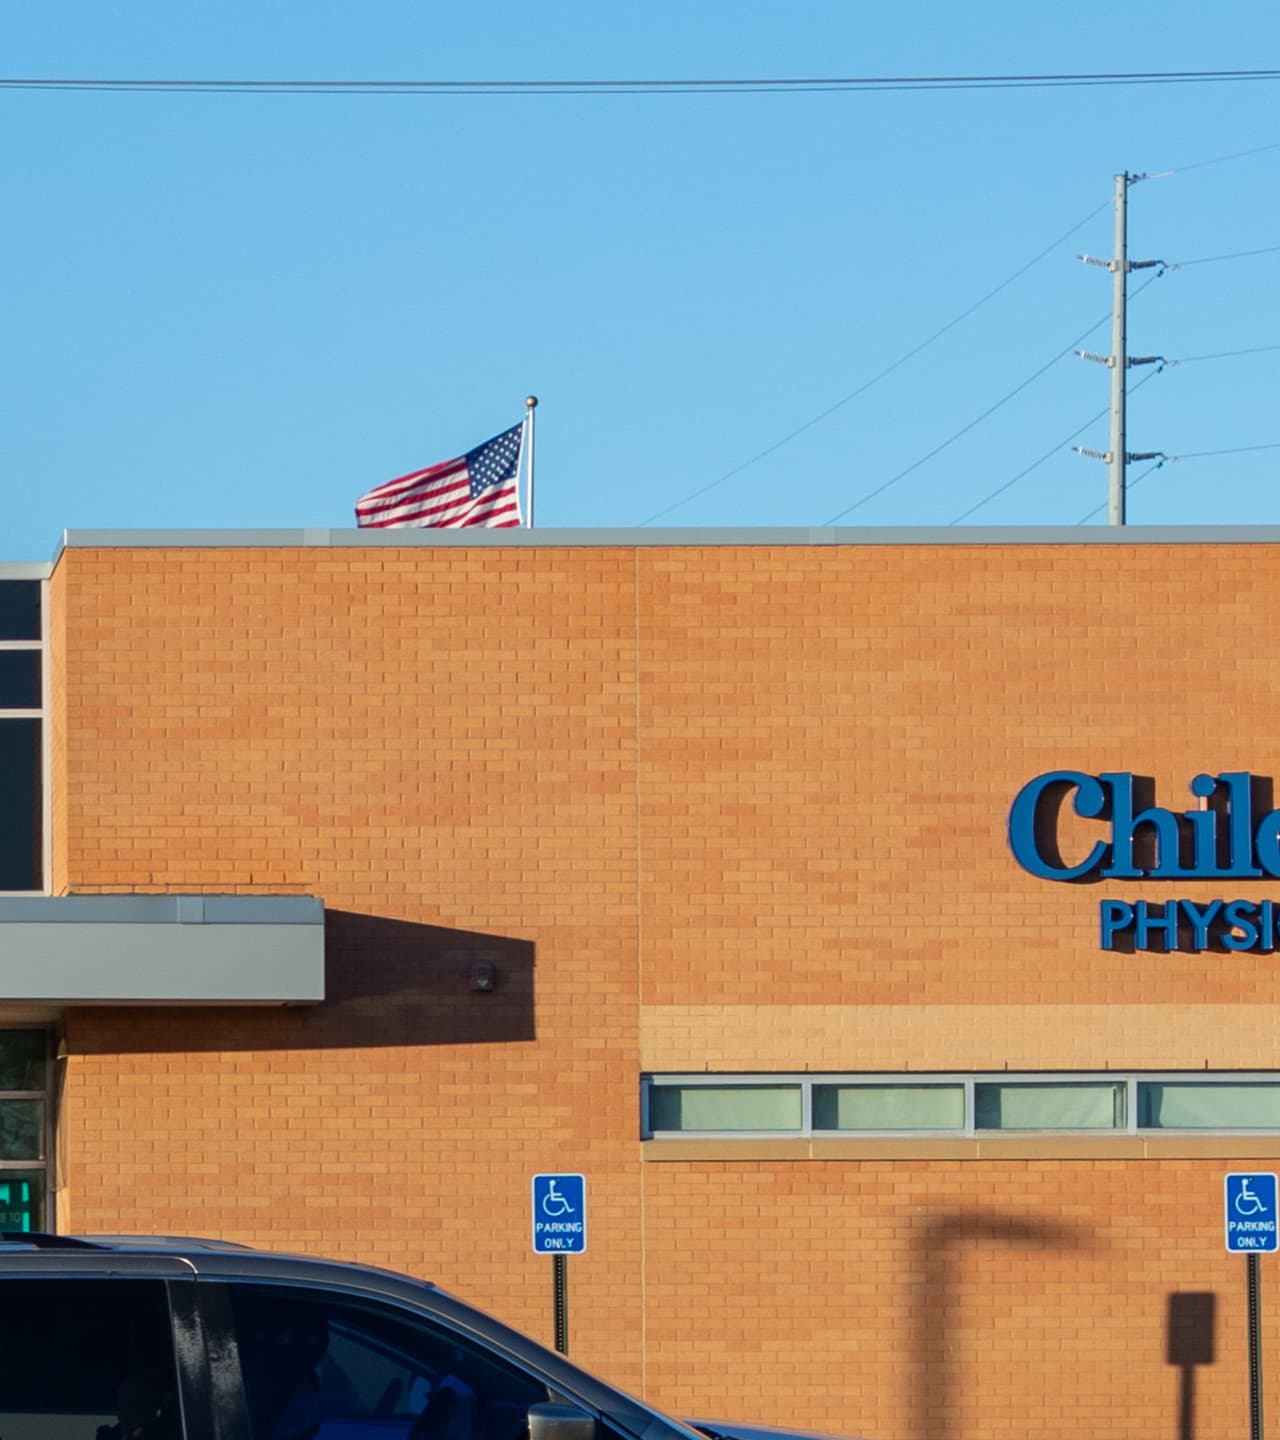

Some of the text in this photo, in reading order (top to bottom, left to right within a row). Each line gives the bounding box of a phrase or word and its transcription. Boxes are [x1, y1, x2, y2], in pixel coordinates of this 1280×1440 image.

[535, 1222, 583, 1233] PARKING
[1228, 1221, 1276, 1232] PARKING
[544, 1238, 575, 1249] ONLY
[1237, 1237, 1268, 1248] ONLY
